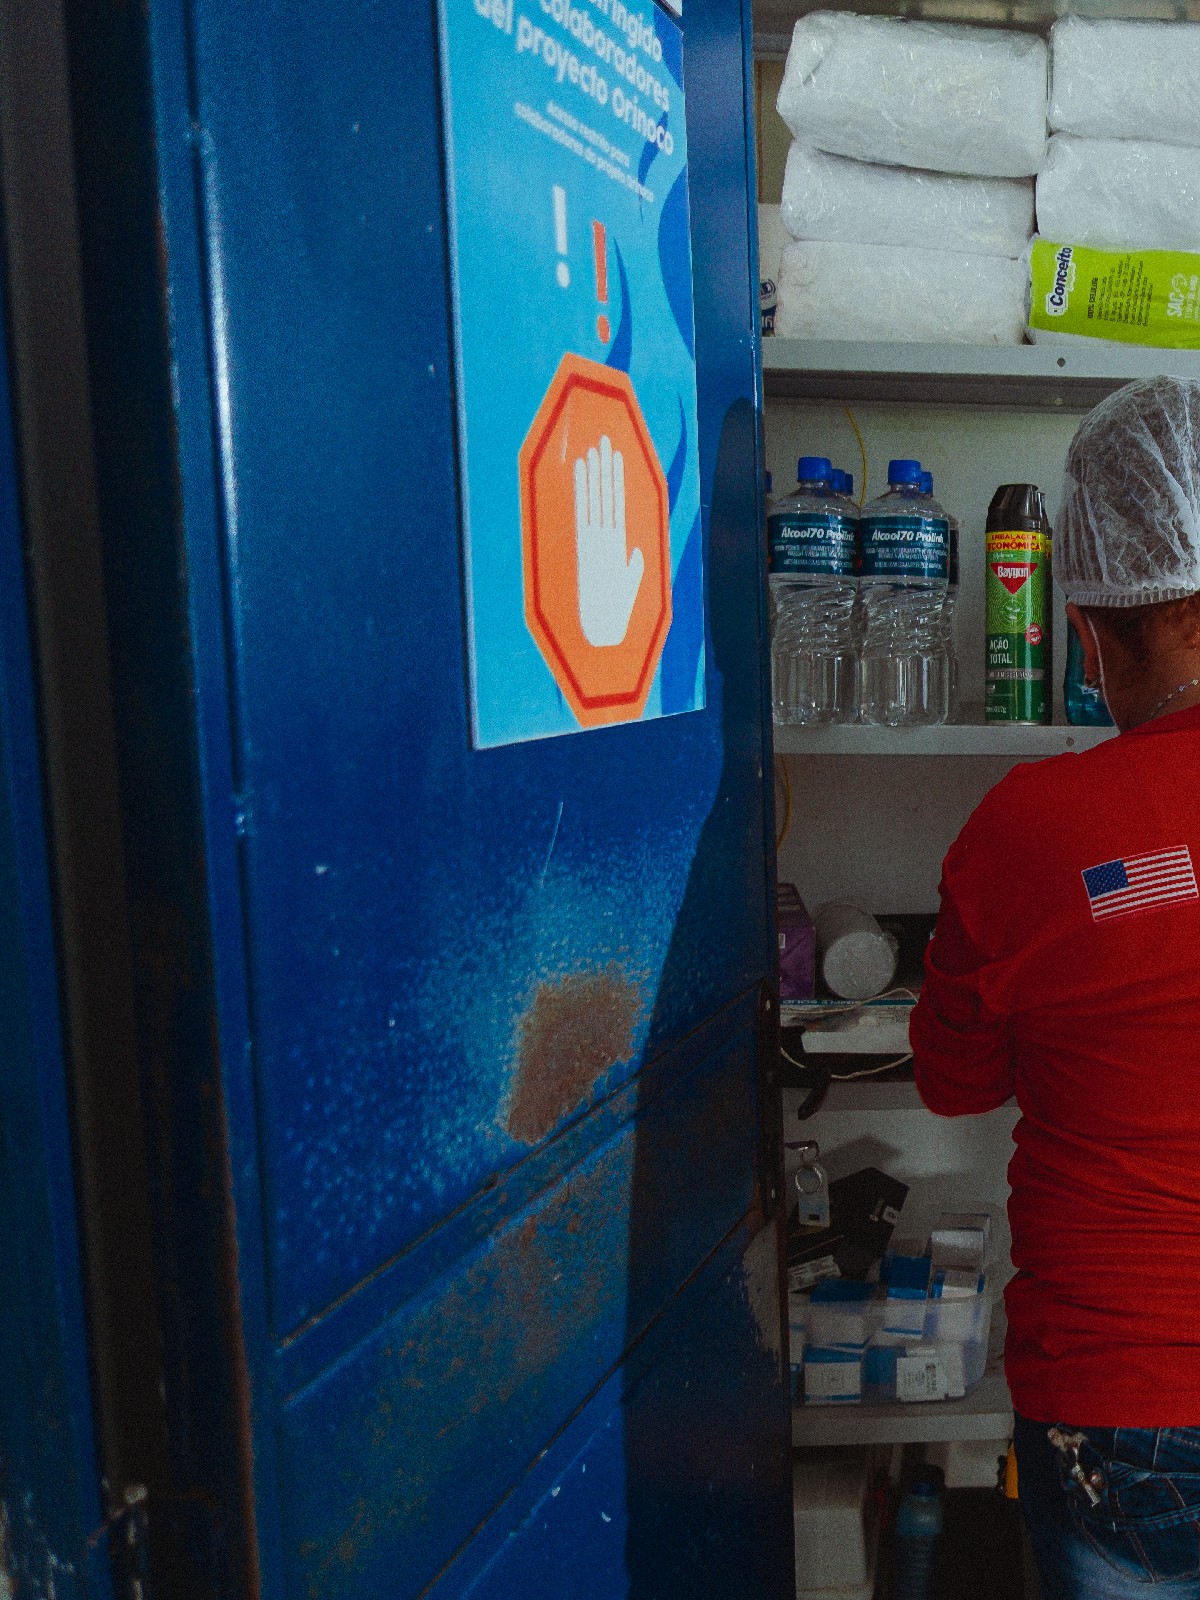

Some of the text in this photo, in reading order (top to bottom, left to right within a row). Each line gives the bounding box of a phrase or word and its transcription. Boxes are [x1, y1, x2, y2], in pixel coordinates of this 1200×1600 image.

[515, 13, 608, 105] proyecto
[611, 86, 674, 156] Orinoco
[1050, 247, 1072, 307] Conceito
[1167, 291, 1185, 318] SAC
[991, 533, 1037, 541] EMBALAGEM
[987, 539, 1041, 551] ECONÔMICA
[997, 565, 1029, 579] Baygon
[989, 636, 1009, 652] AÇÃO
[990, 653, 1012, 664] TOTAL
